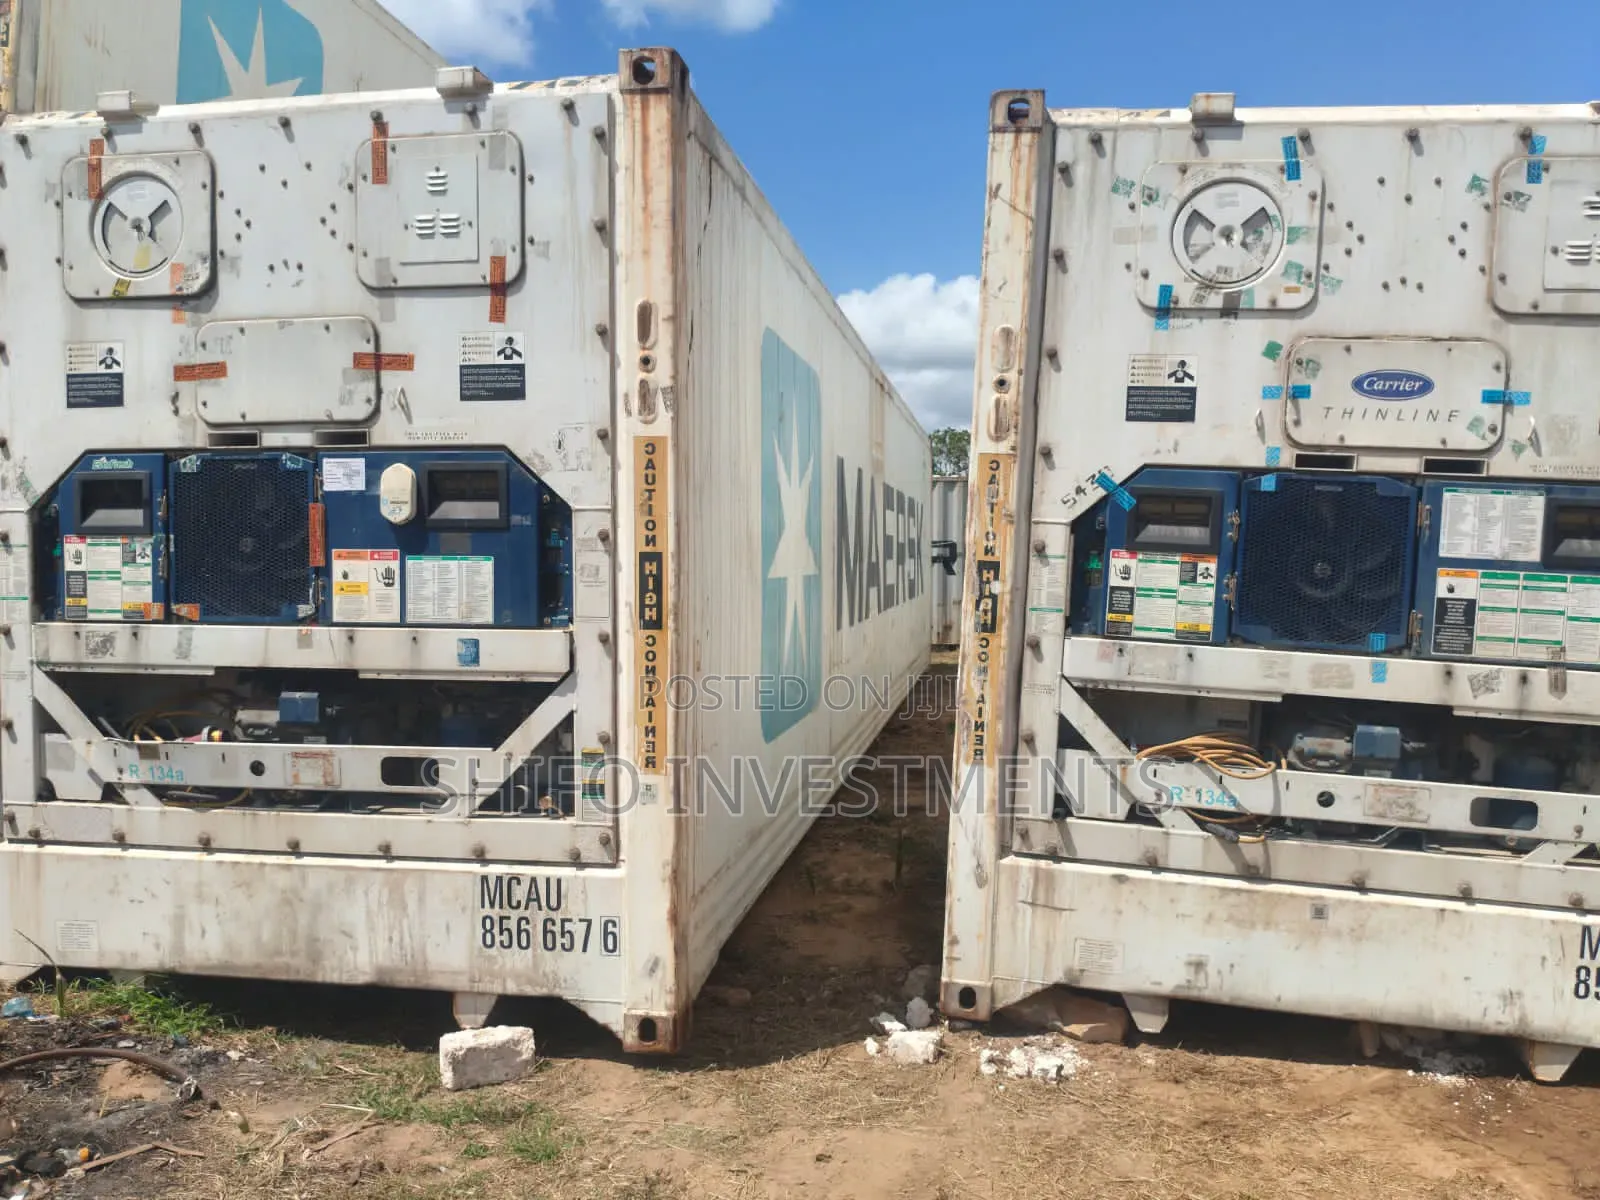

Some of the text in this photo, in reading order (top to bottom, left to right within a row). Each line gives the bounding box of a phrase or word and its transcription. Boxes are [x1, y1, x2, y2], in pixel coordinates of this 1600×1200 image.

[1363, 376, 1424, 393] Carrier
[1323, 406, 1460, 423] THINLINE
[836, 455, 924, 632] MAERSK
[128, 763, 184, 781] R 134a
[480, 874, 562, 911] MCAU
[481, 914, 618, 953] 856 657 6
